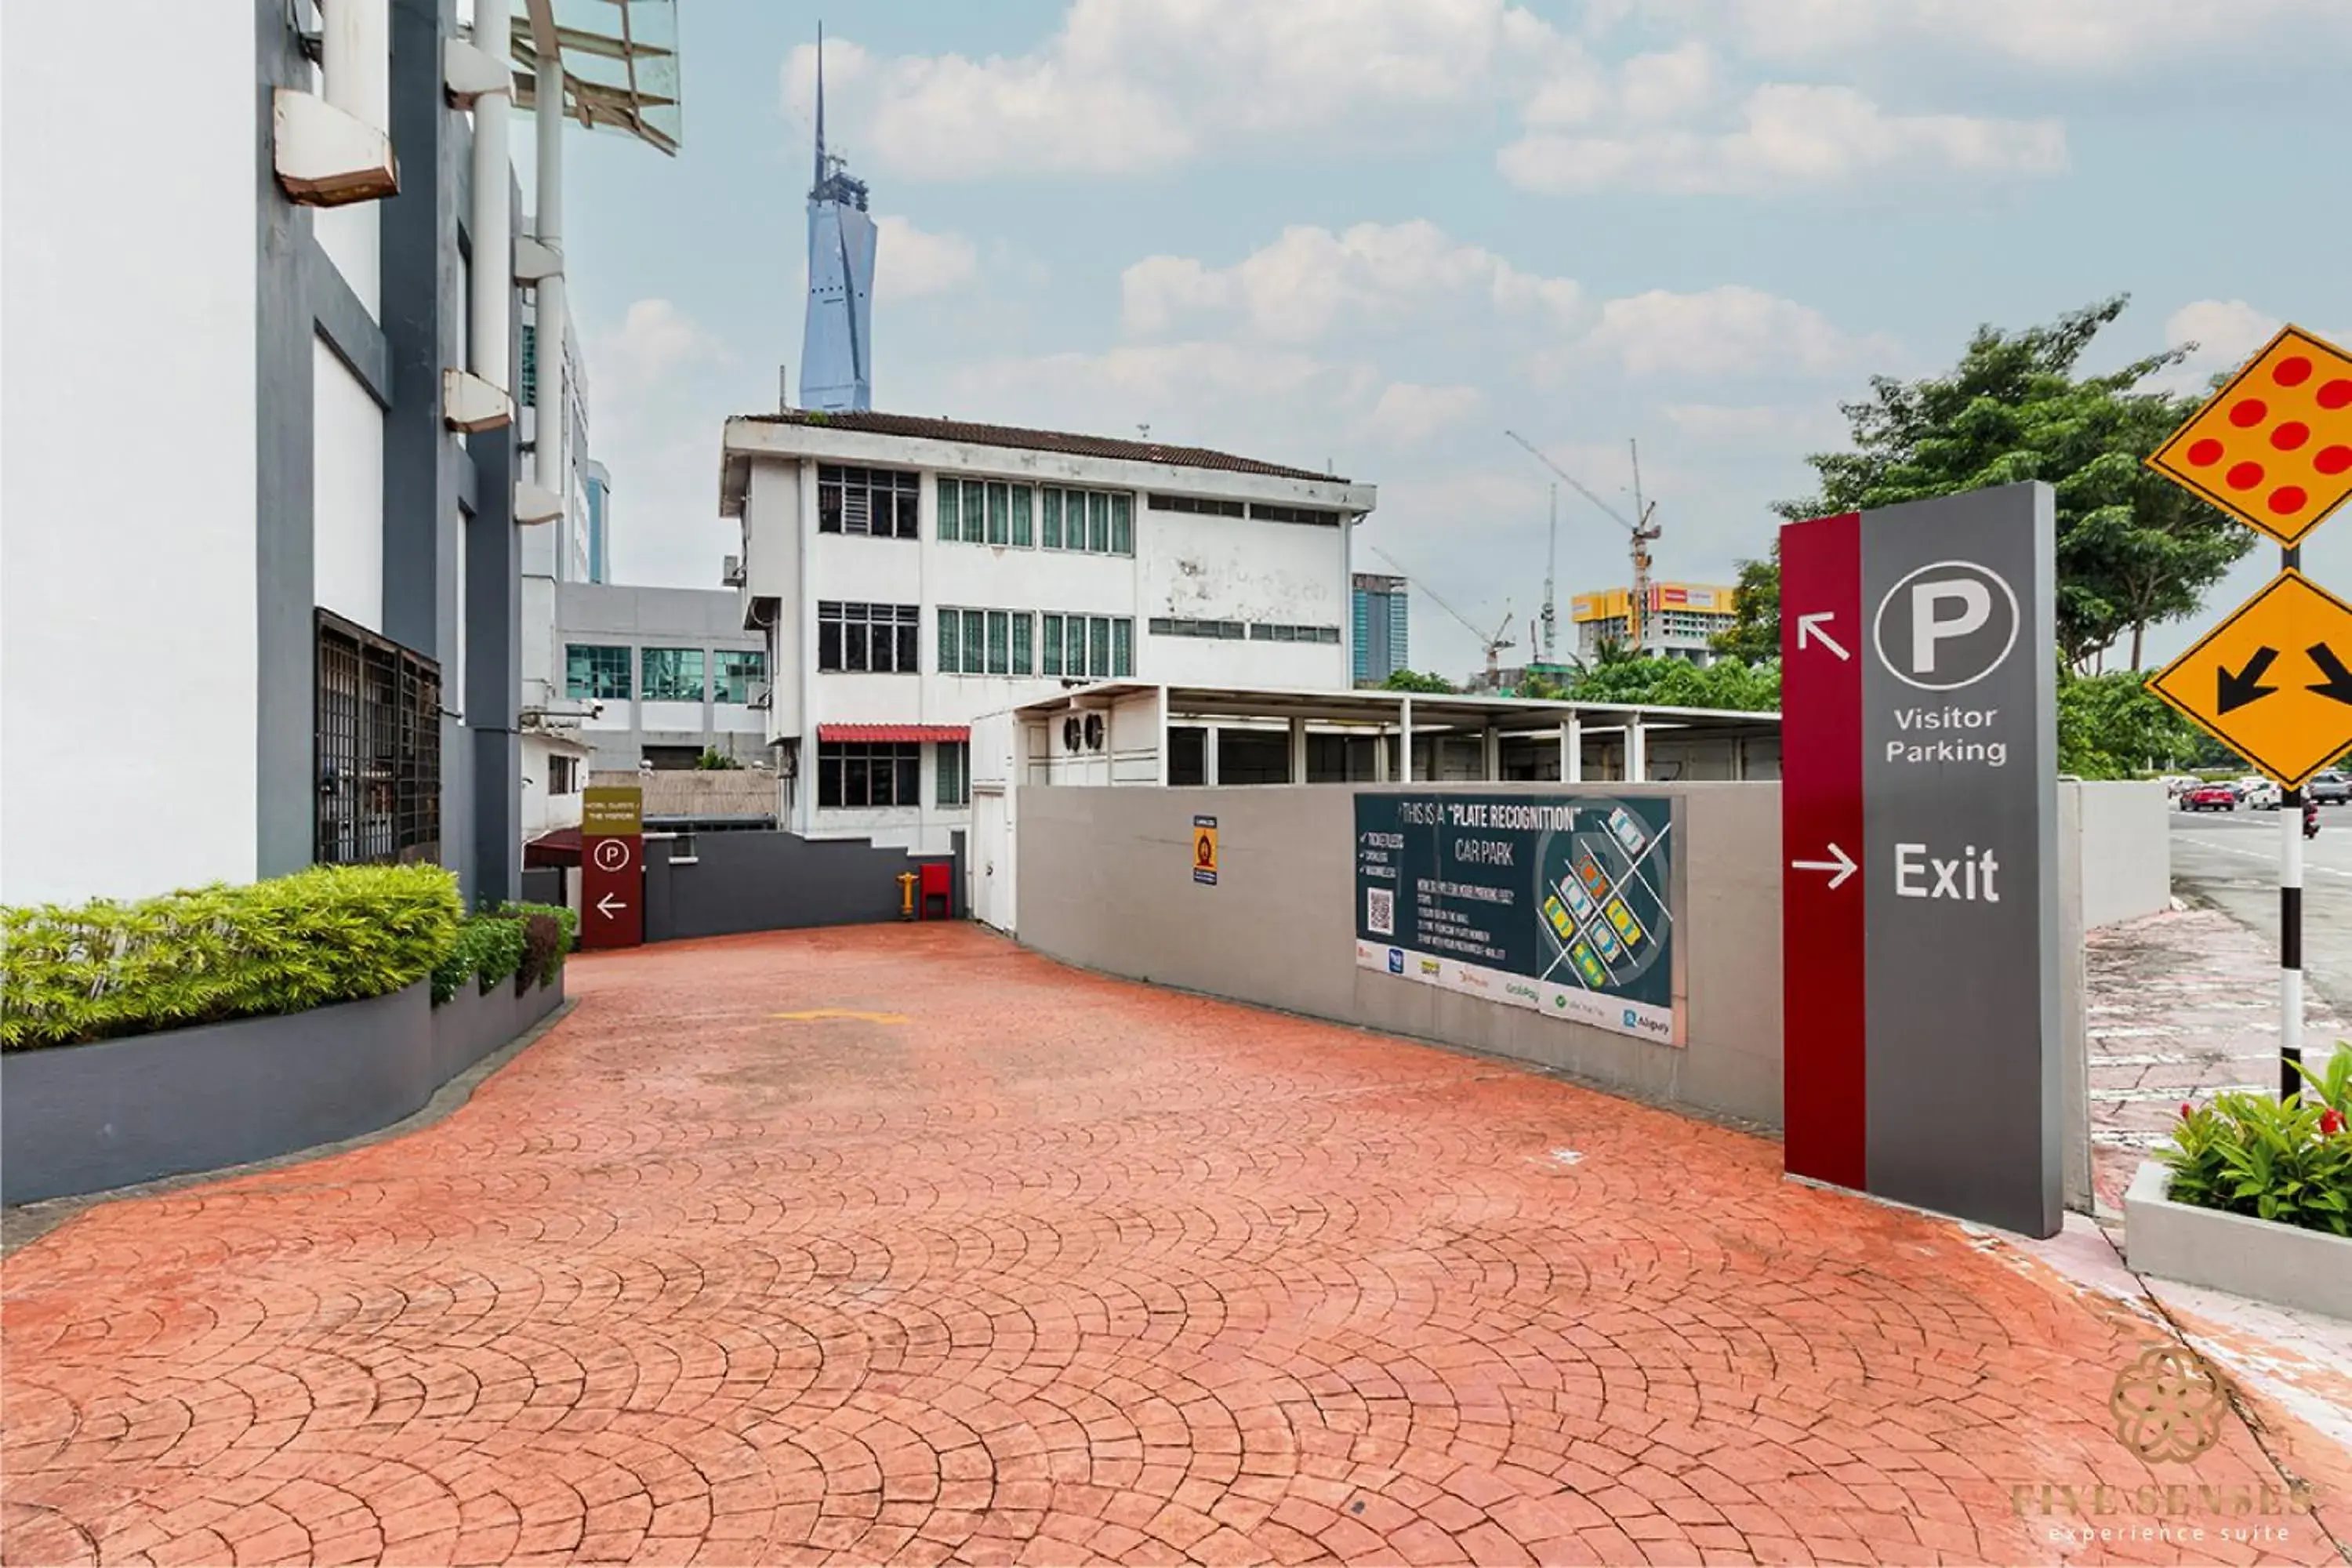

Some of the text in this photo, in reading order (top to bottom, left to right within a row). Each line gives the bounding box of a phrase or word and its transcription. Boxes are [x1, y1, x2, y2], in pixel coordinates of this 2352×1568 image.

[1912, 578, 1991, 673] P
[1893, 707, 1998, 730] Visitor
[1886, 739, 2007, 767] Parking
[606, 847, 619, 862] P
[1455, 838, 1514, 866] CAR PARK
[1894, 843, 2000, 902] Exit
